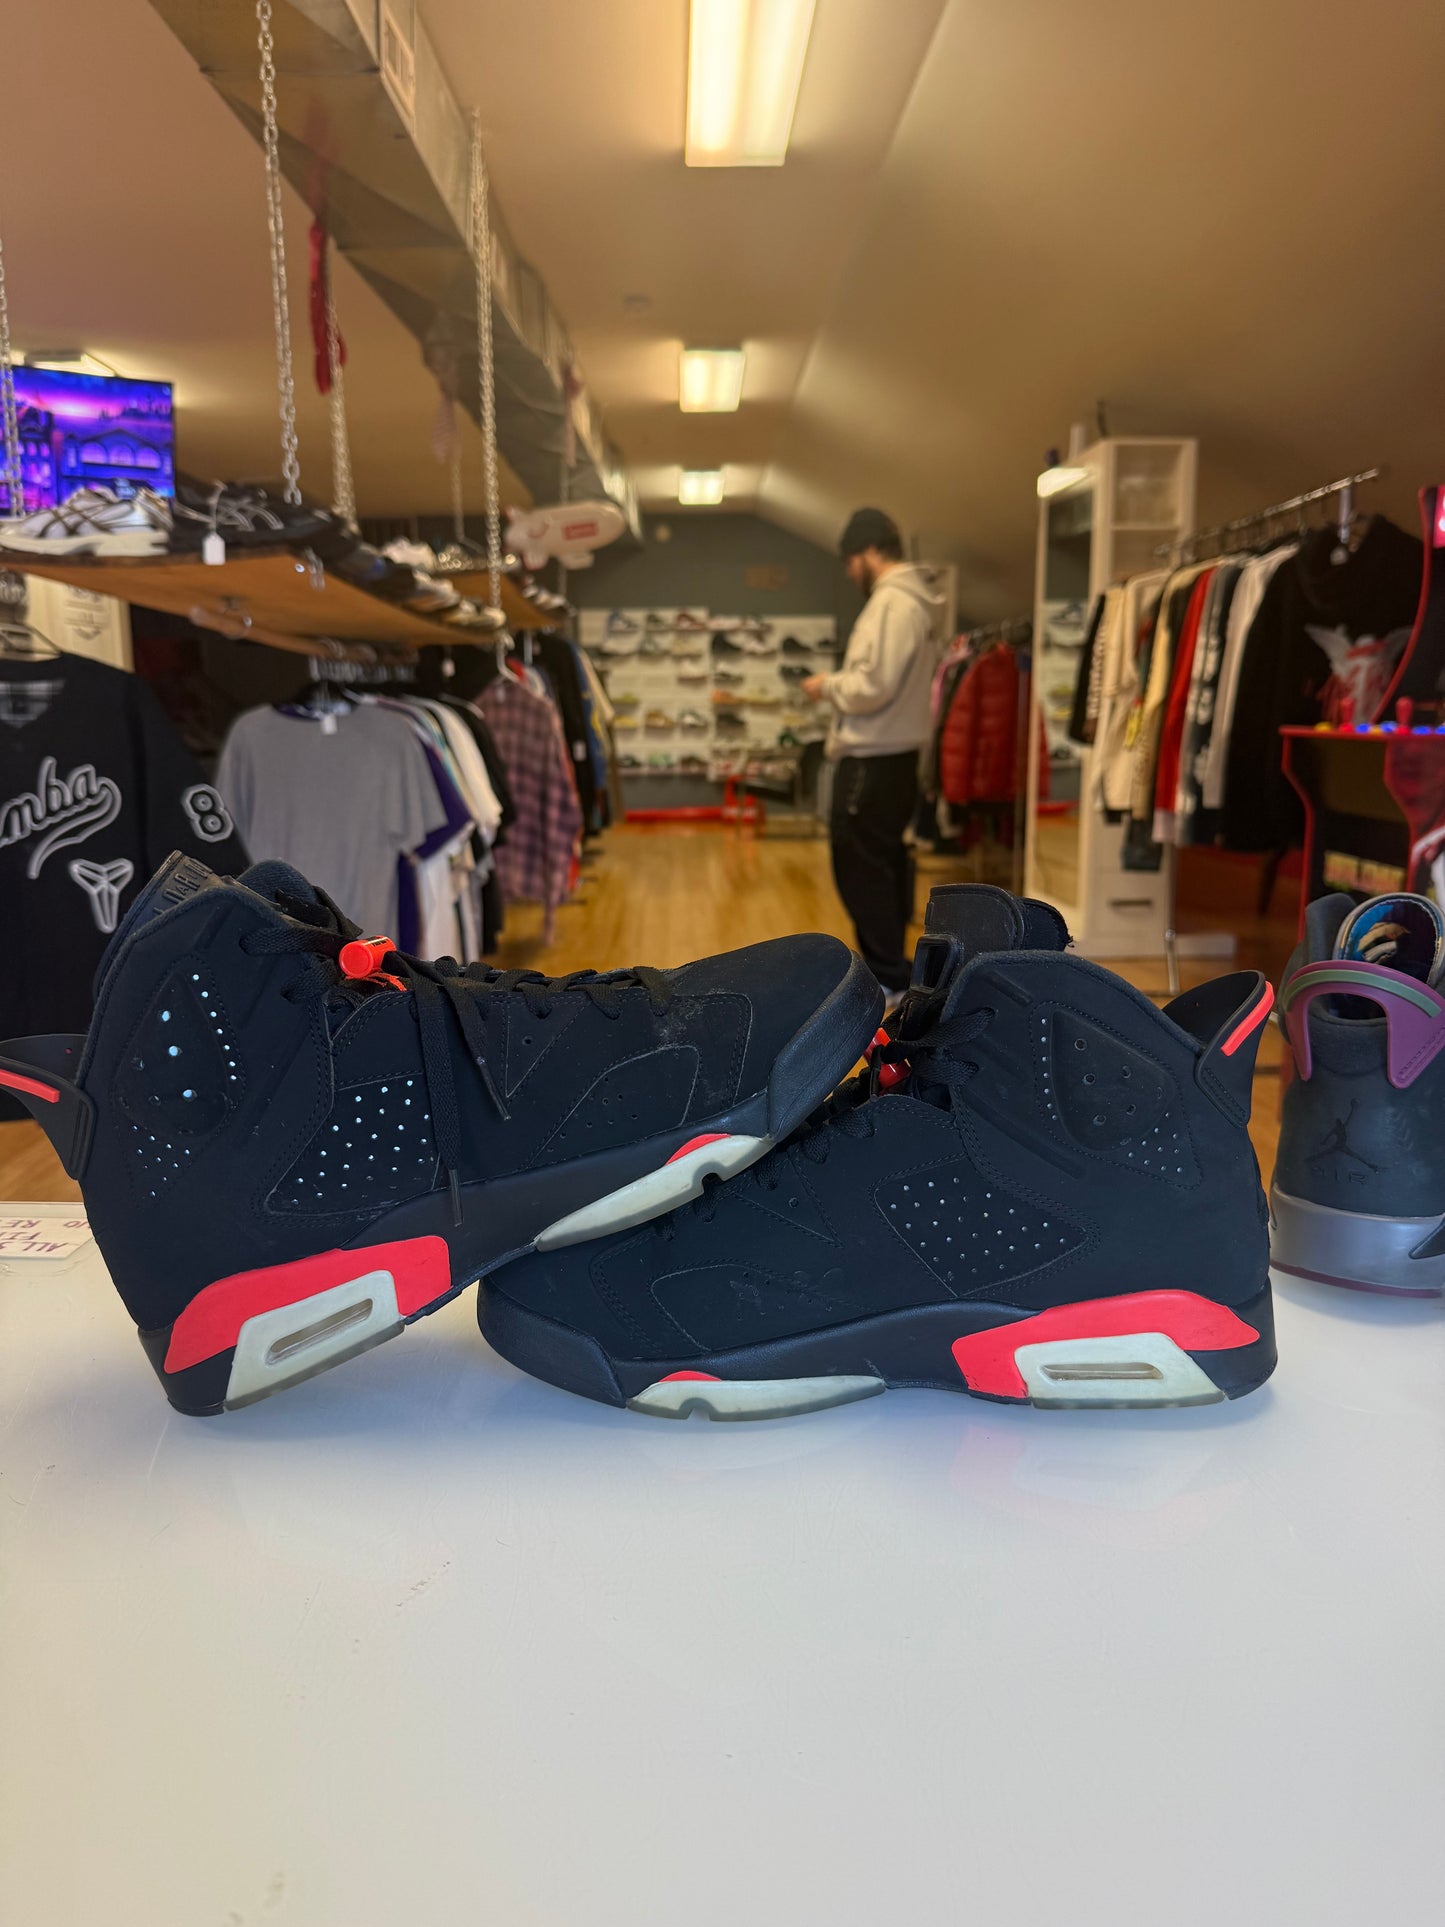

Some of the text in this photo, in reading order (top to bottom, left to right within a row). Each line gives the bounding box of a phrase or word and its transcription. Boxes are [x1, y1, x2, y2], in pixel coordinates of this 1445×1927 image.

[182, 783, 234, 842] 8
[0, 1219, 41, 1229] RE
[21, 1241, 69, 1252] ALL
